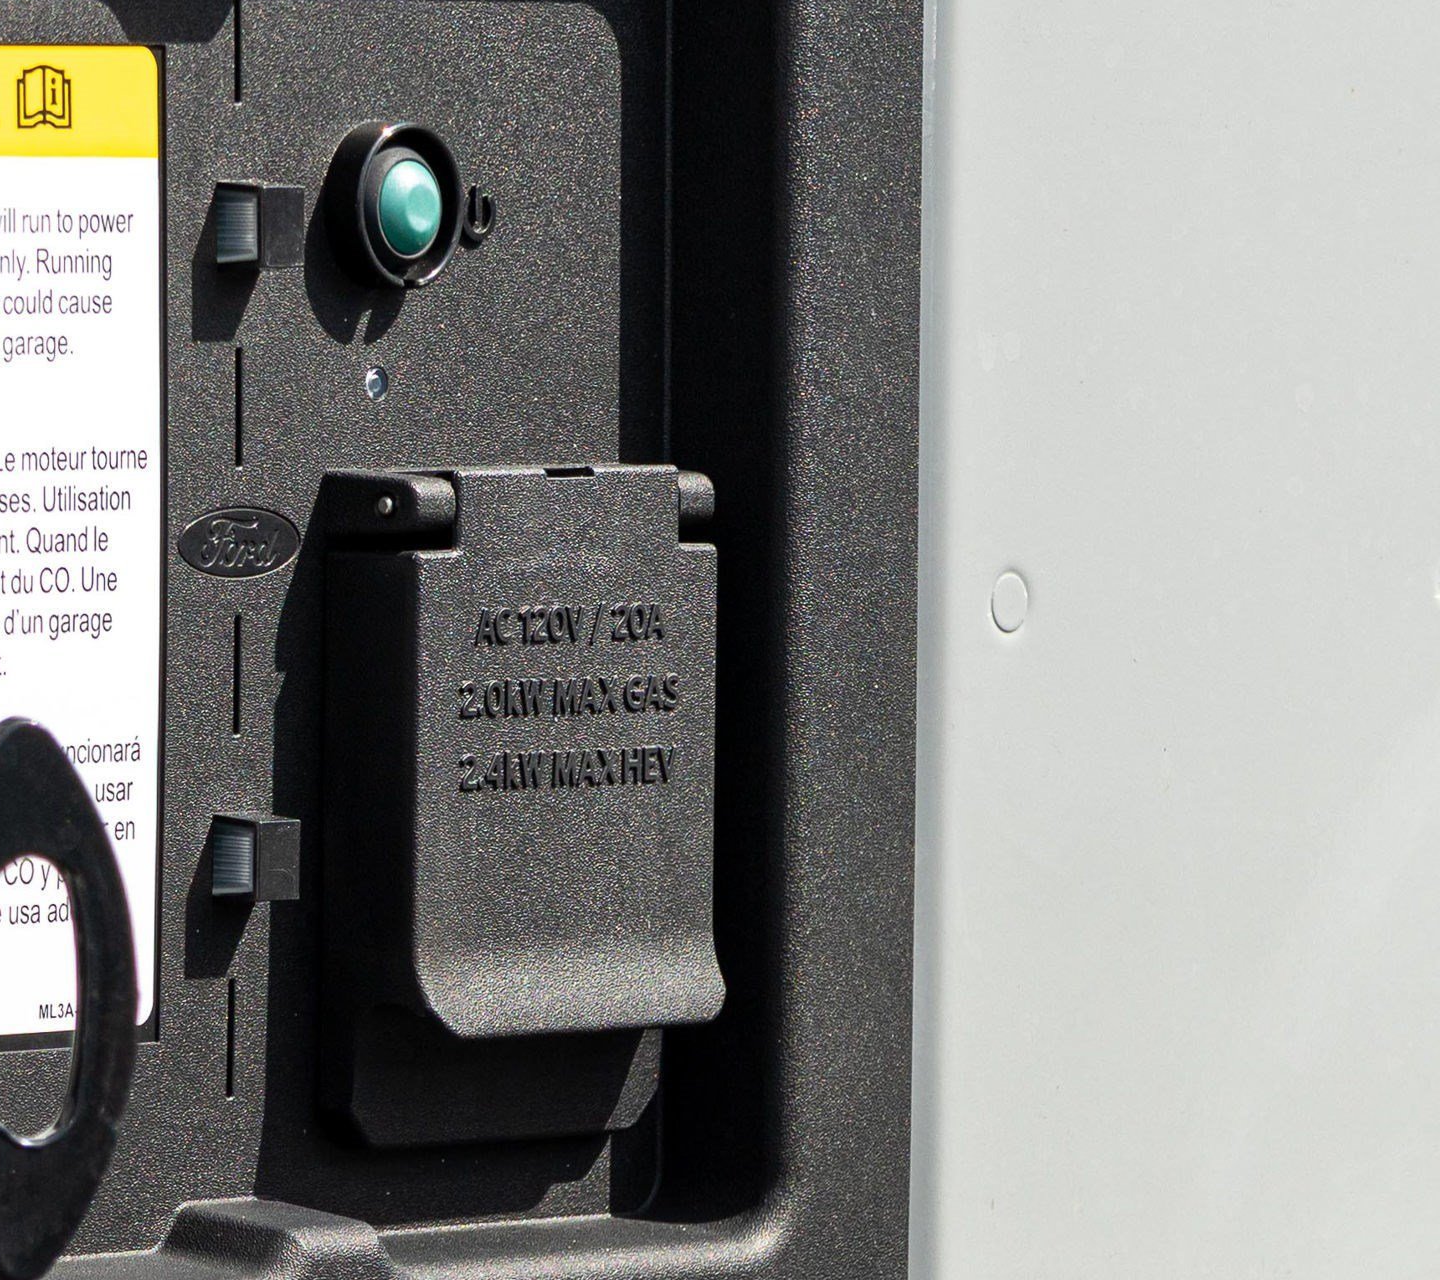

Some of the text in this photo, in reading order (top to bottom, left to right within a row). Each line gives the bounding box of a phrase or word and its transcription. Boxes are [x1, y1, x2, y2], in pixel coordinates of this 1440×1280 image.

[23, 214, 50, 233] run
[57, 210, 73, 233] to
[79, 214, 133, 239] power
[37, 248, 112, 281] Running
[3, 289, 52, 315] could
[59, 295, 112, 314] cause
[3, 336, 73, 362] garage.
[22, 447, 87, 471] moteur
[92, 446, 147, 470] tourne
[43, 485, 130, 512] Utilisation
[26, 526, 88, 554] Quand
[94, 526, 108, 551] le
[200, 516, 281, 568] Ford
[11, 569, 33, 594] du
[40, 567, 74, 593] CO.
[82, 566, 117, 592] Une
[49, 613, 112, 640] garage
[475, 606, 514, 647] AC
[518, 604, 583, 646] 120V
[611, 602, 666, 642] 20A
[552, 676, 622, 717] MAX
[623, 673, 680, 712] GAS
[552, 749, 620, 790] MAX
[622, 744, 677, 786] HEV
[95, 781, 134, 803] usar
[115, 821, 135, 840] en
[9, 905, 40, 925] usa
